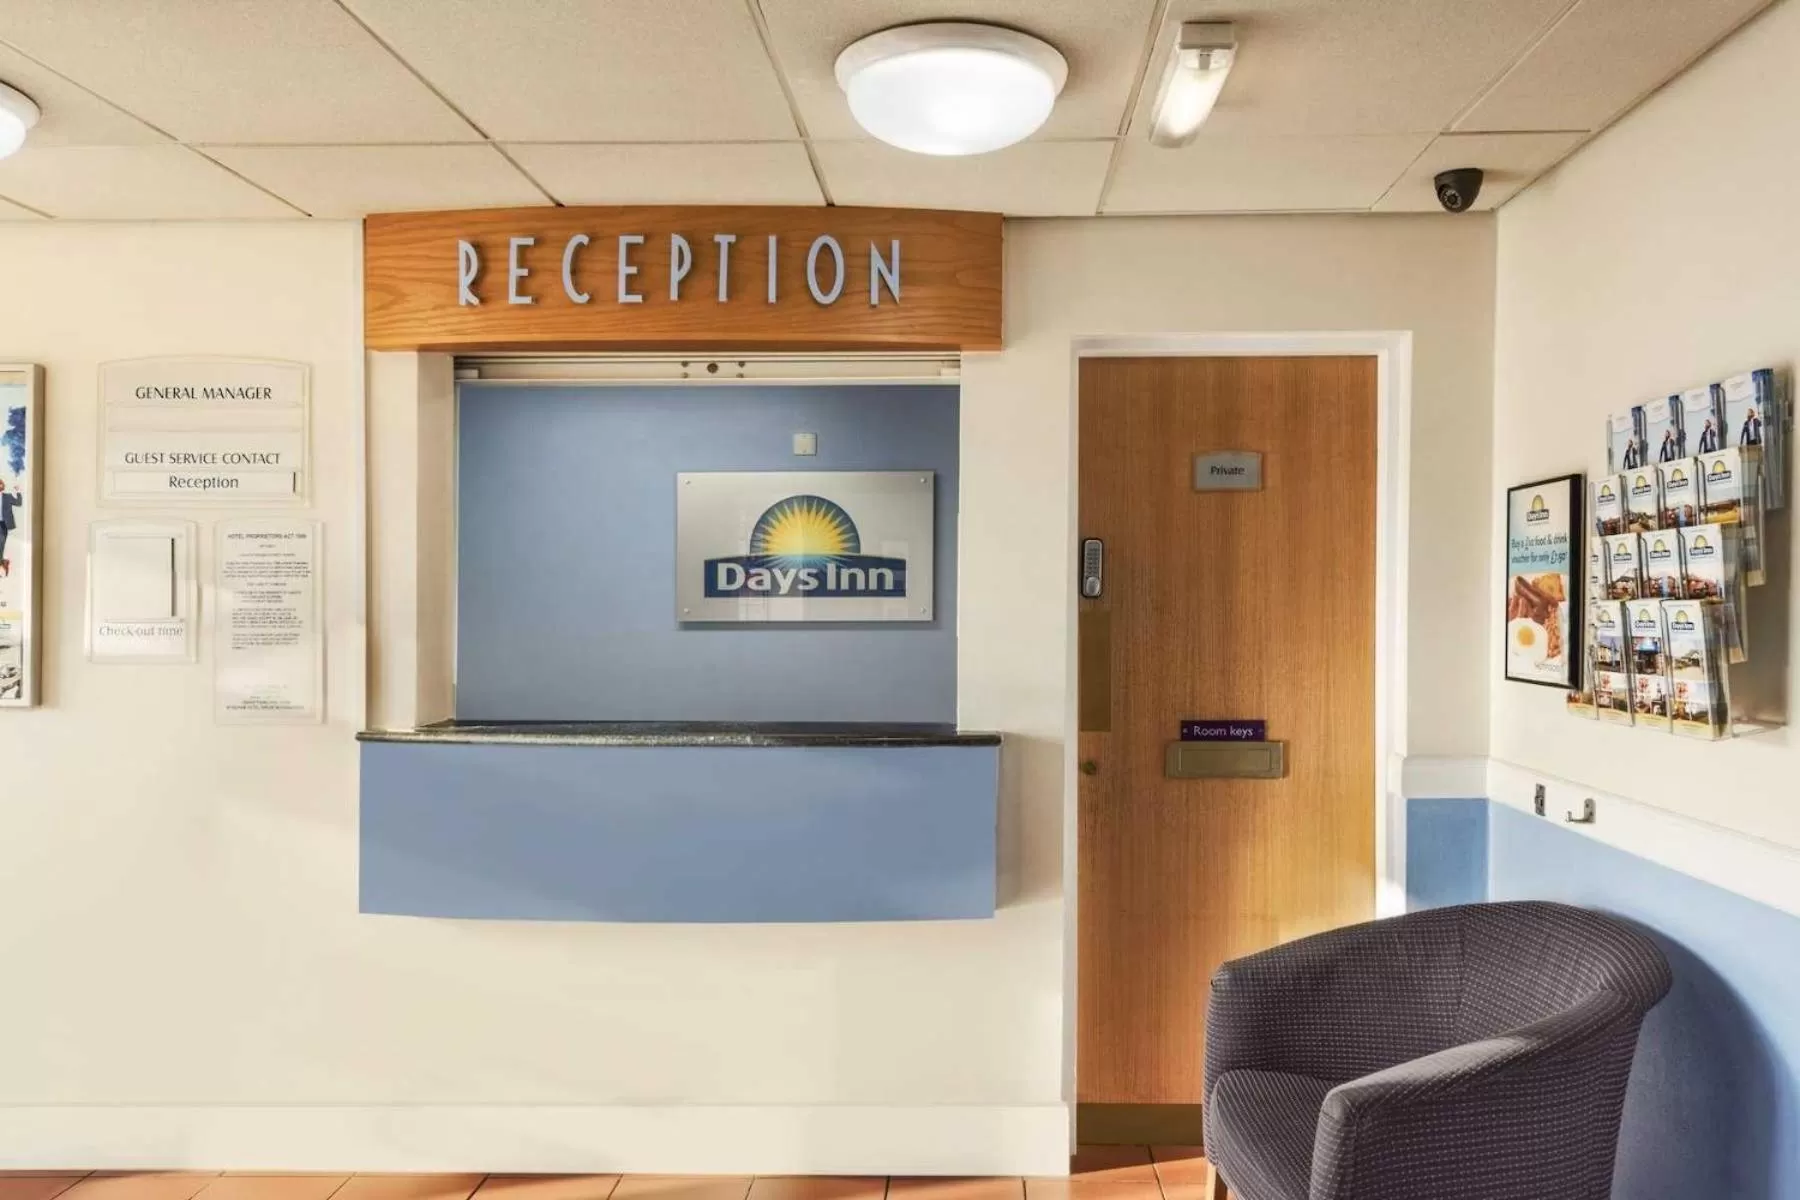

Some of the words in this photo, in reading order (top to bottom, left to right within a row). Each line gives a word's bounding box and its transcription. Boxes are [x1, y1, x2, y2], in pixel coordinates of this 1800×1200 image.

[458, 232, 900, 306] RECEPTION
[135, 386, 198, 400] GENERAL
[202, 386, 273, 400] MANAGER
[124, 452, 165, 465] GUEST
[169, 452, 218, 465] SERVICE
[222, 452, 281, 465] CONTACT
[1210, 465, 1246, 476] Private
[168, 475, 239, 491] Reception
[98, 625, 155, 637] Check-out
[158, 625, 183, 637] time
[1193, 725, 1227, 736] Room
[1230, 725, 1254, 739] keys
